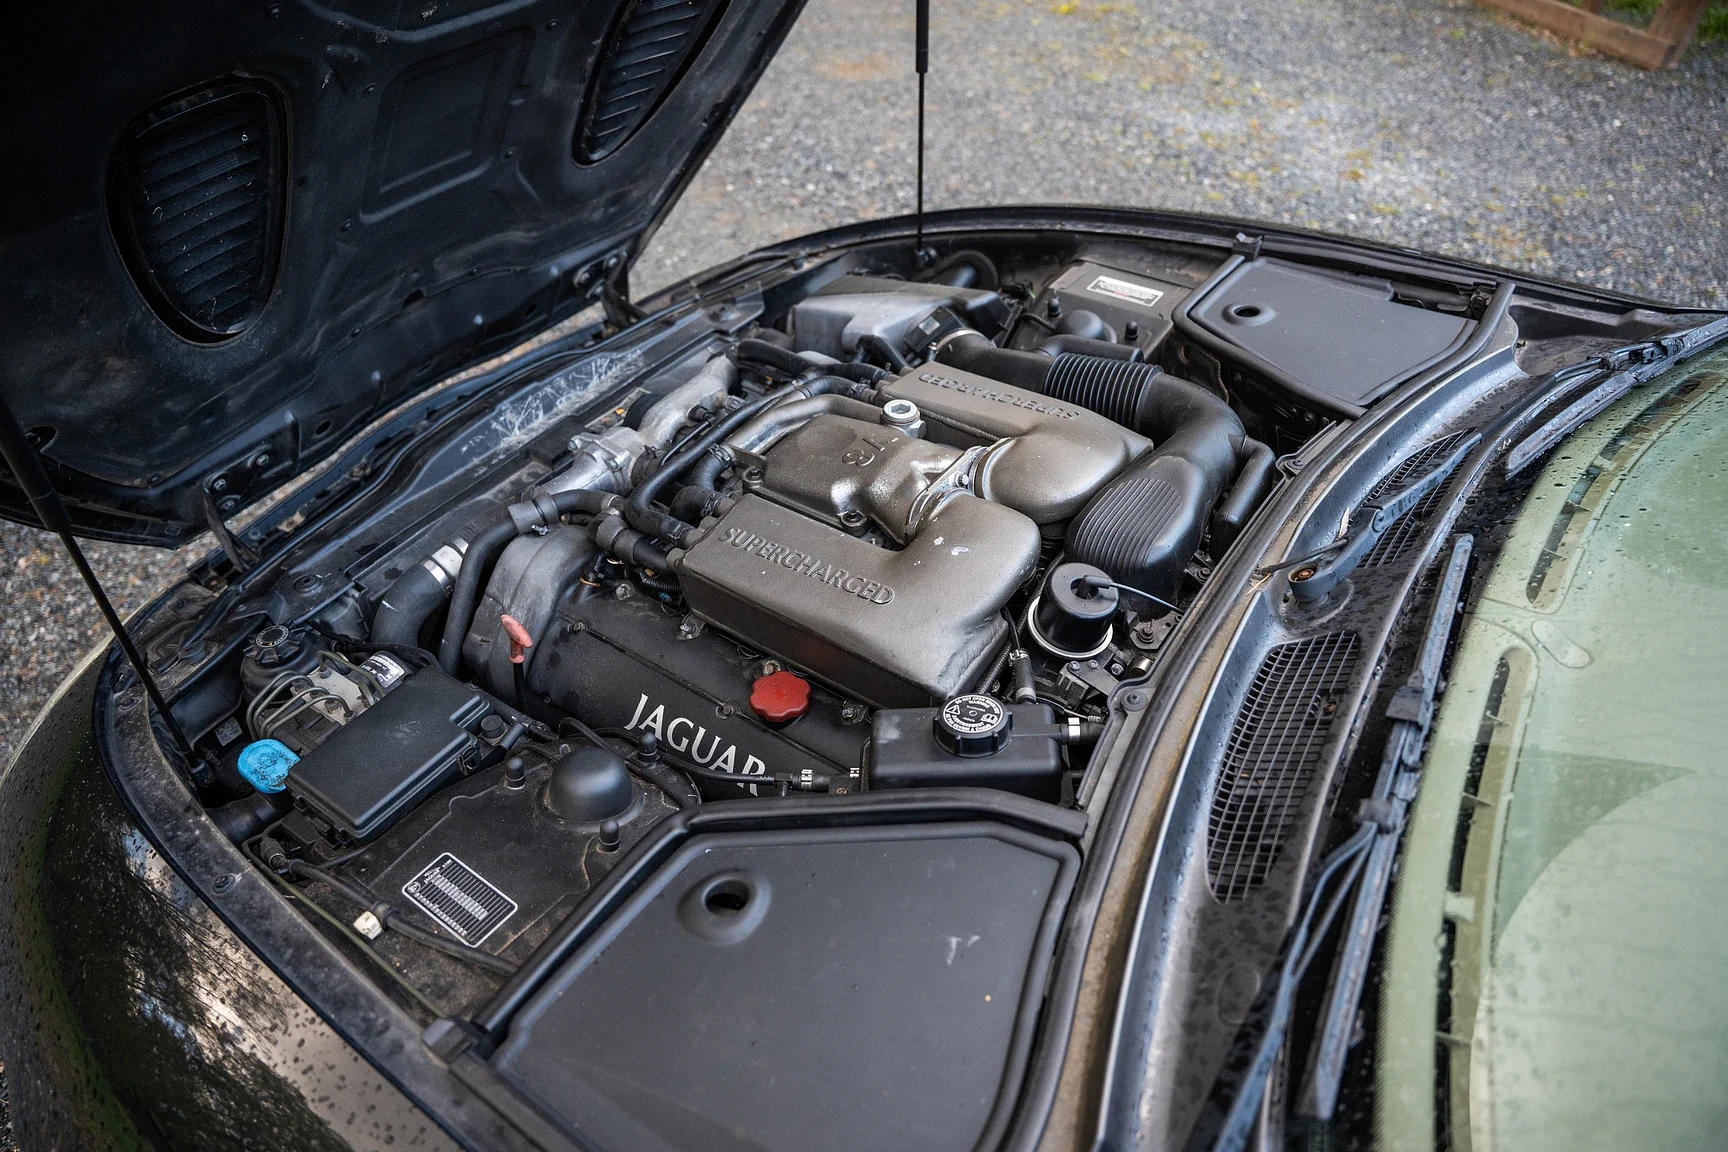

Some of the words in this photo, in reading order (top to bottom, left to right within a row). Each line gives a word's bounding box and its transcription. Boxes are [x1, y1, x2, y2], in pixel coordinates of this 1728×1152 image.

[918, 373, 1080, 421] SUPERCHARGED
[719, 526, 895, 605] SUPERCHARGED
[624, 694, 766, 796] JAGUAR
